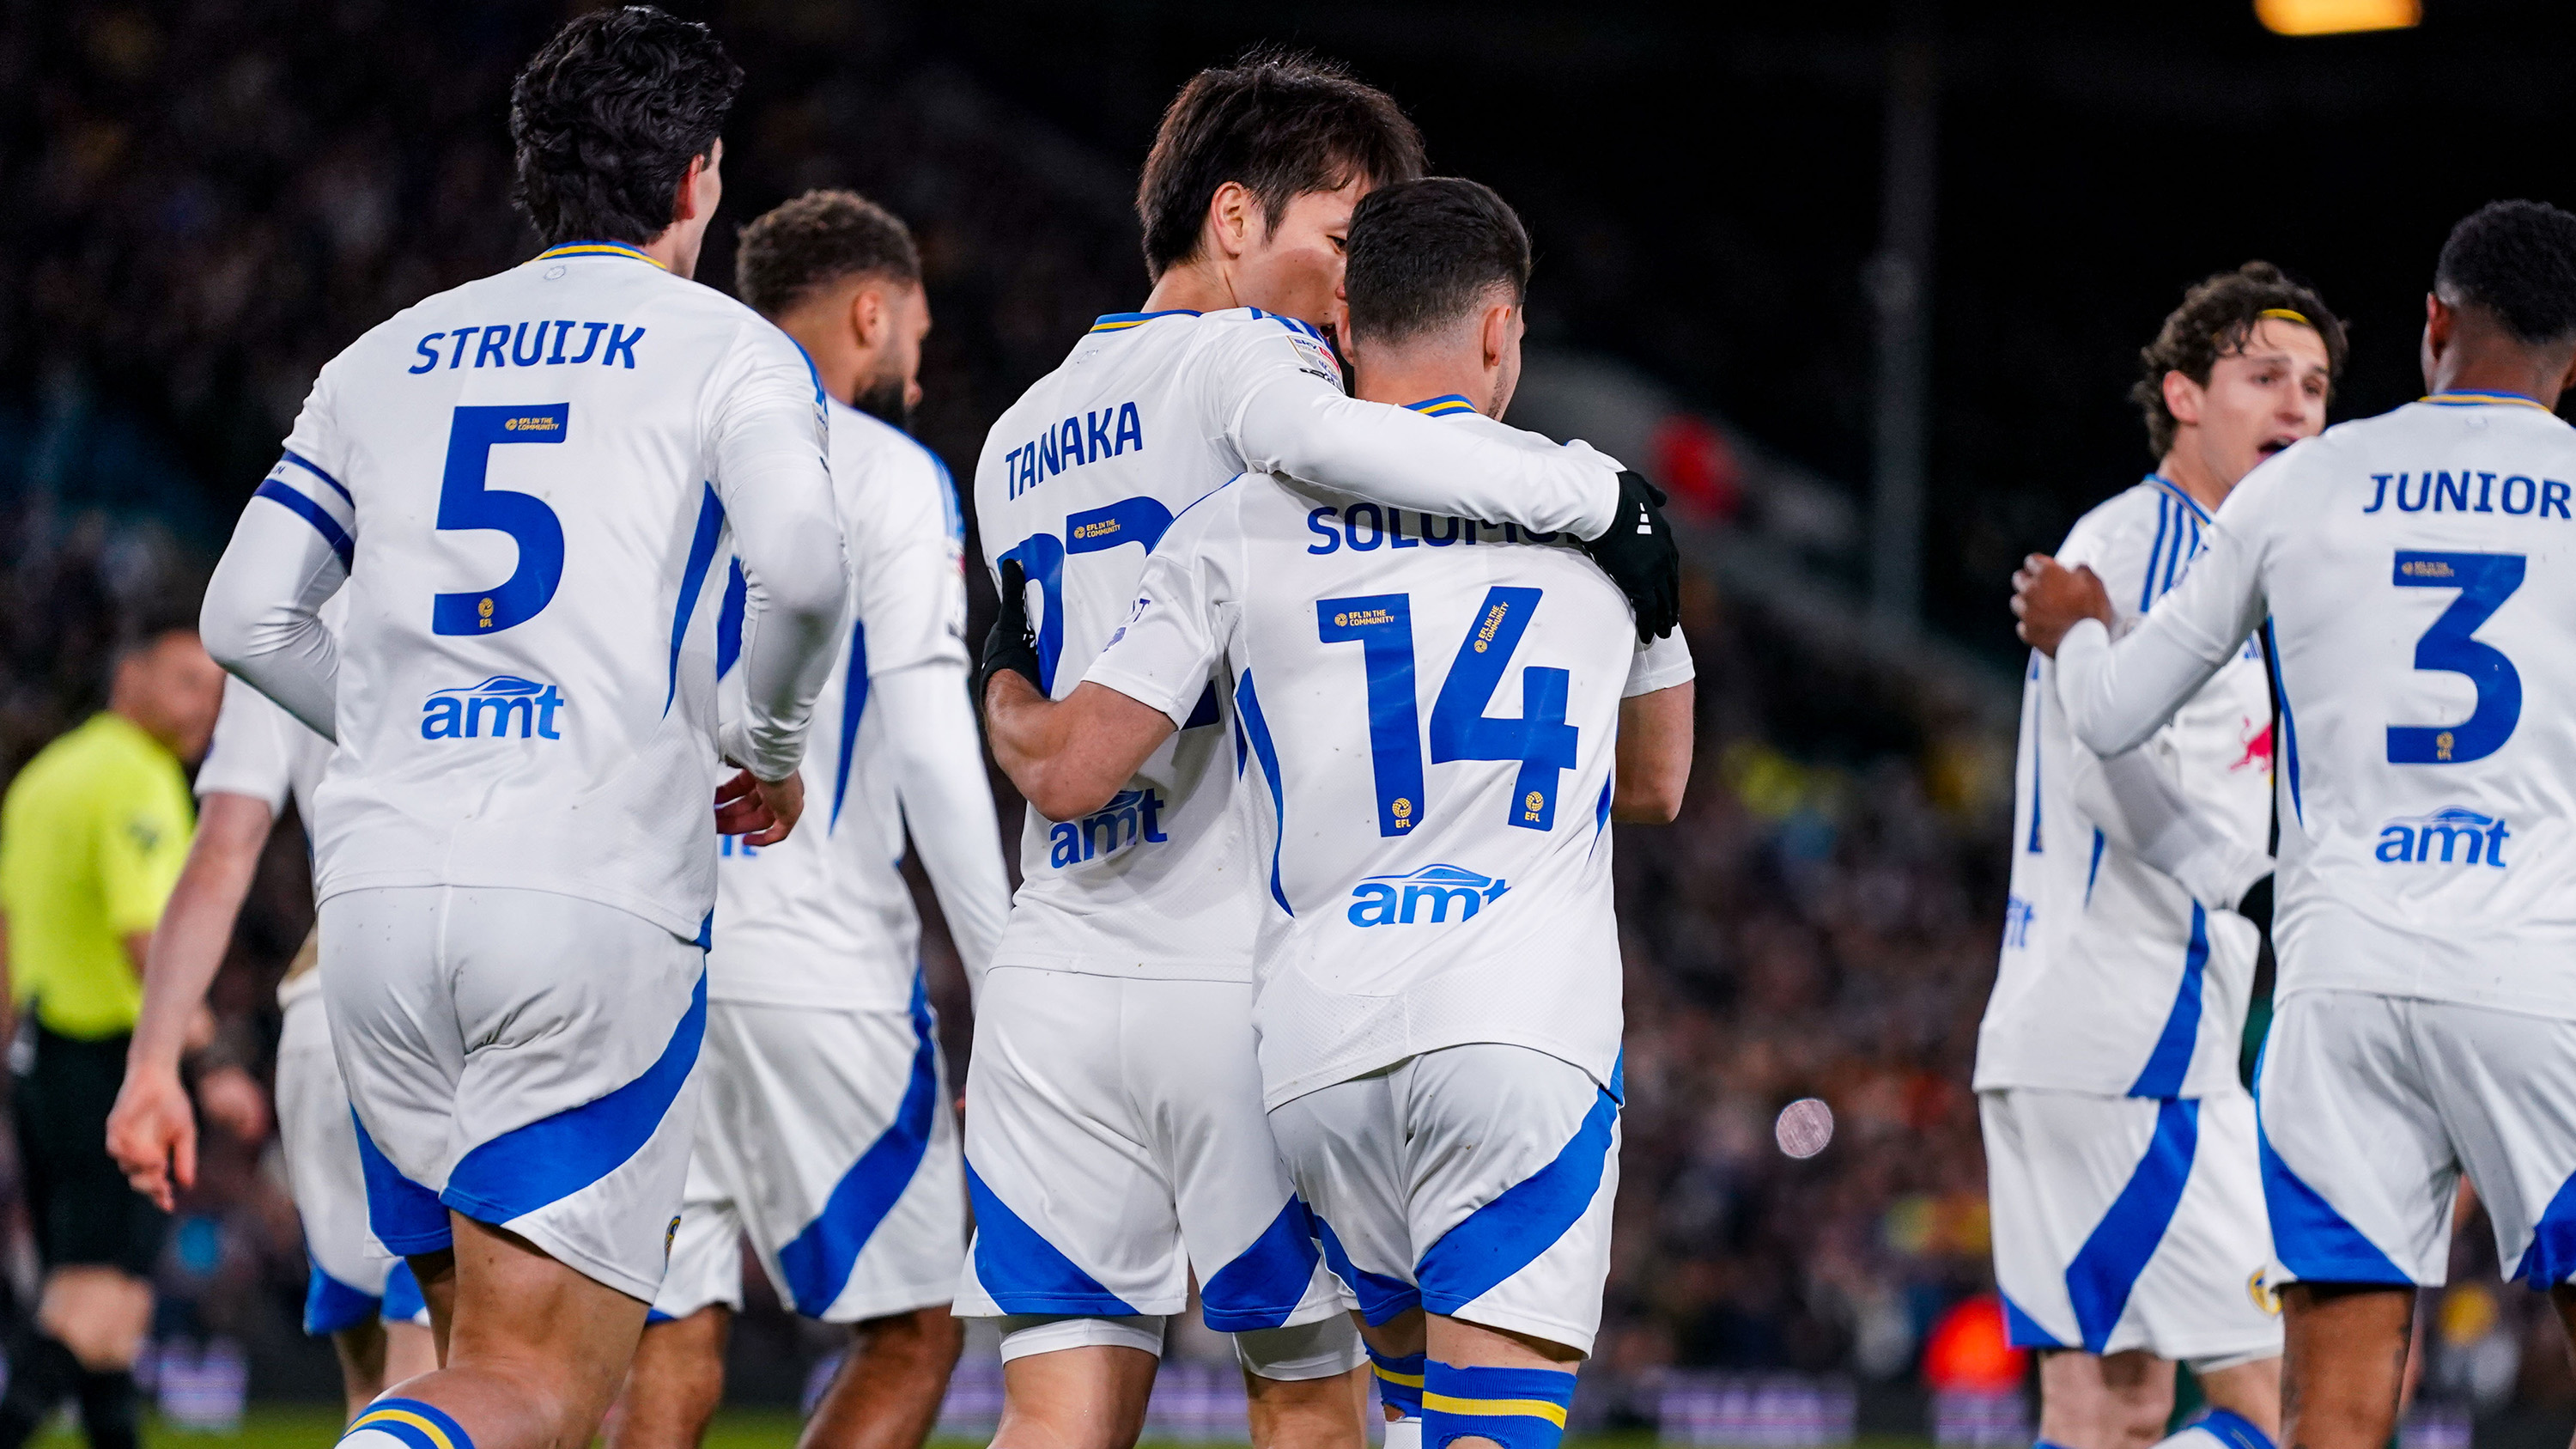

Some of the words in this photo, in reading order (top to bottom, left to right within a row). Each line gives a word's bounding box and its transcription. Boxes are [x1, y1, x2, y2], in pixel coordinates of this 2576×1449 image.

[408, 320, 646, 374] STRUIJK
[1005, 401, 1143, 502] TANAKA
[2363, 469, 2573, 520] JUNIOR
[432, 402, 570, 636] 5
[1086, 523, 1098, 532] EFL
[1106, 518, 1115, 527] THE
[1086, 524, 1121, 539] COMMUNITY
[1349, 611, 1363, 619] EFL
[1349, 615, 1394, 626] COMMUNITY
[1484, 617, 1493, 628] IN
[1485, 601, 1509, 642] COMMUNITY
[1488, 605, 1500, 618] THE
[1478, 626, 1490, 639] EFL
[2386, 551, 2527, 764] 3
[421, 685, 564, 740] amt
[1316, 585, 1579, 837] 14
[1050, 788, 1168, 869] amt
[1395, 819, 1411, 828] EFL
[1525, 812, 1540, 822] EFL
[2375, 819, 2511, 868] amt
